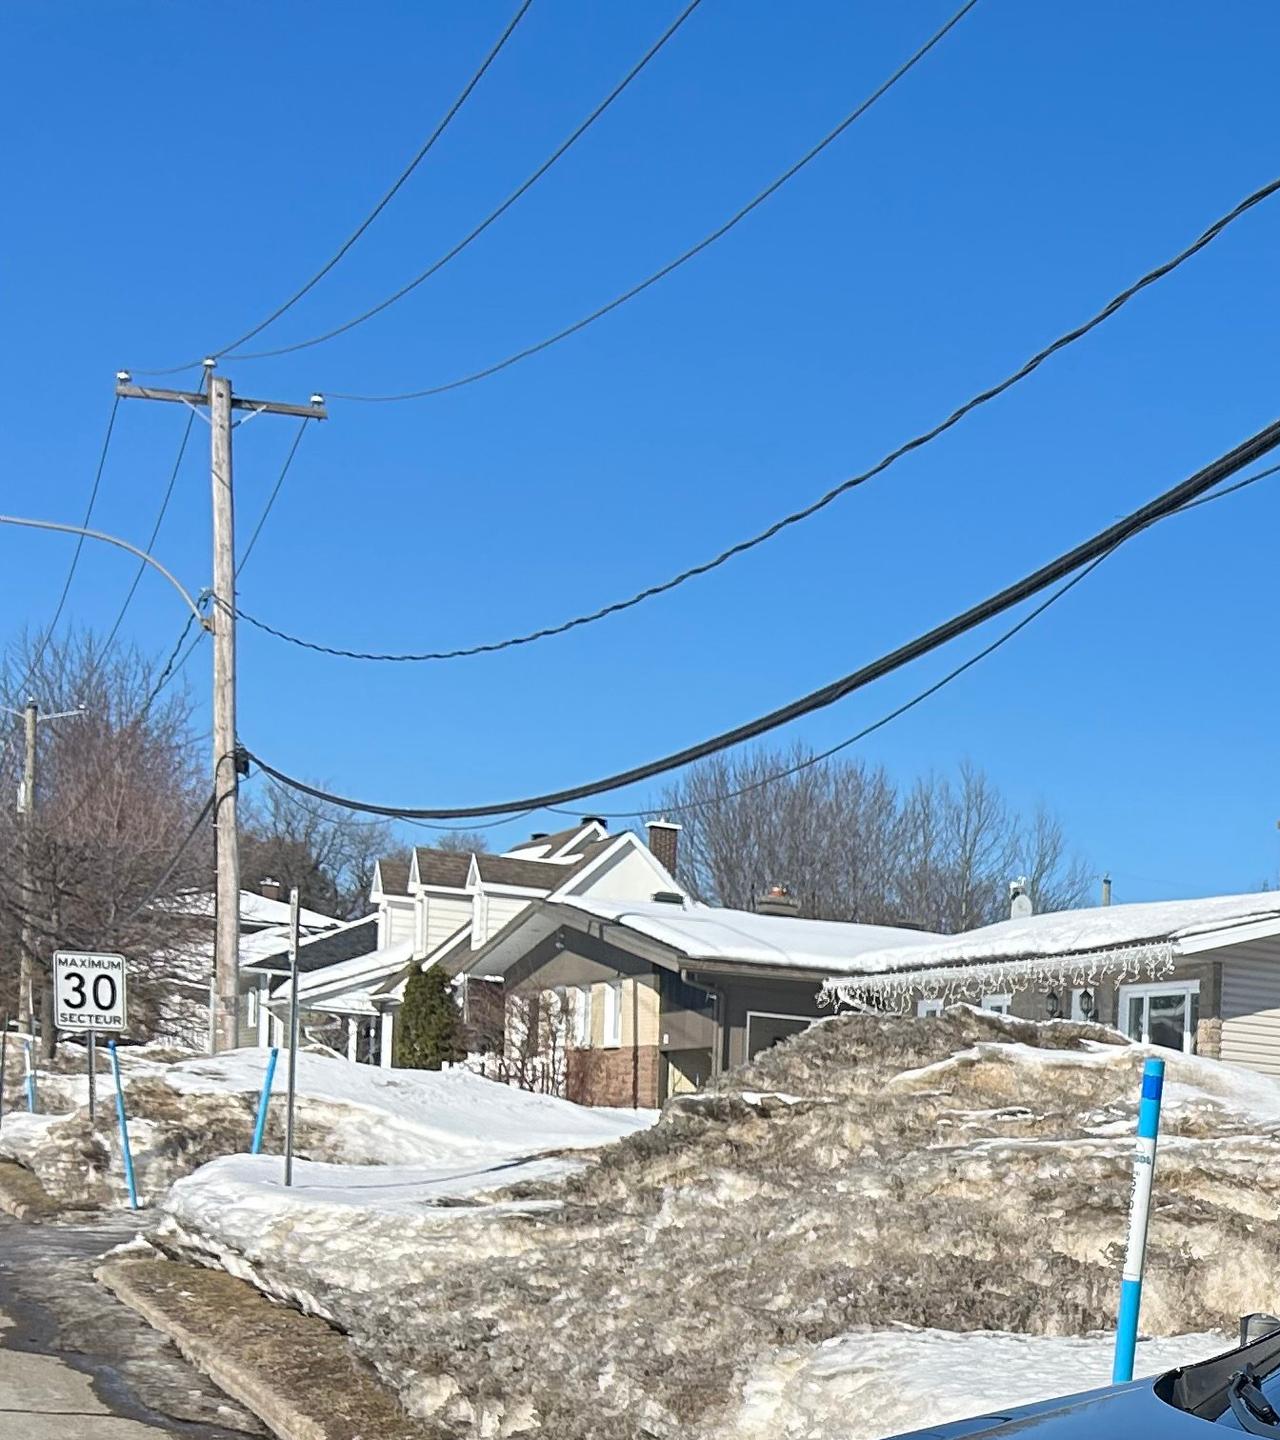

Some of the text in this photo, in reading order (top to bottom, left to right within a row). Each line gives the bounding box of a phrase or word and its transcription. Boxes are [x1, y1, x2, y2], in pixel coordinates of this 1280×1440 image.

[58, 957, 121, 970] MAXIMUM
[63, 972, 117, 1011] 30
[60, 1013, 122, 1025] SECTEUR
